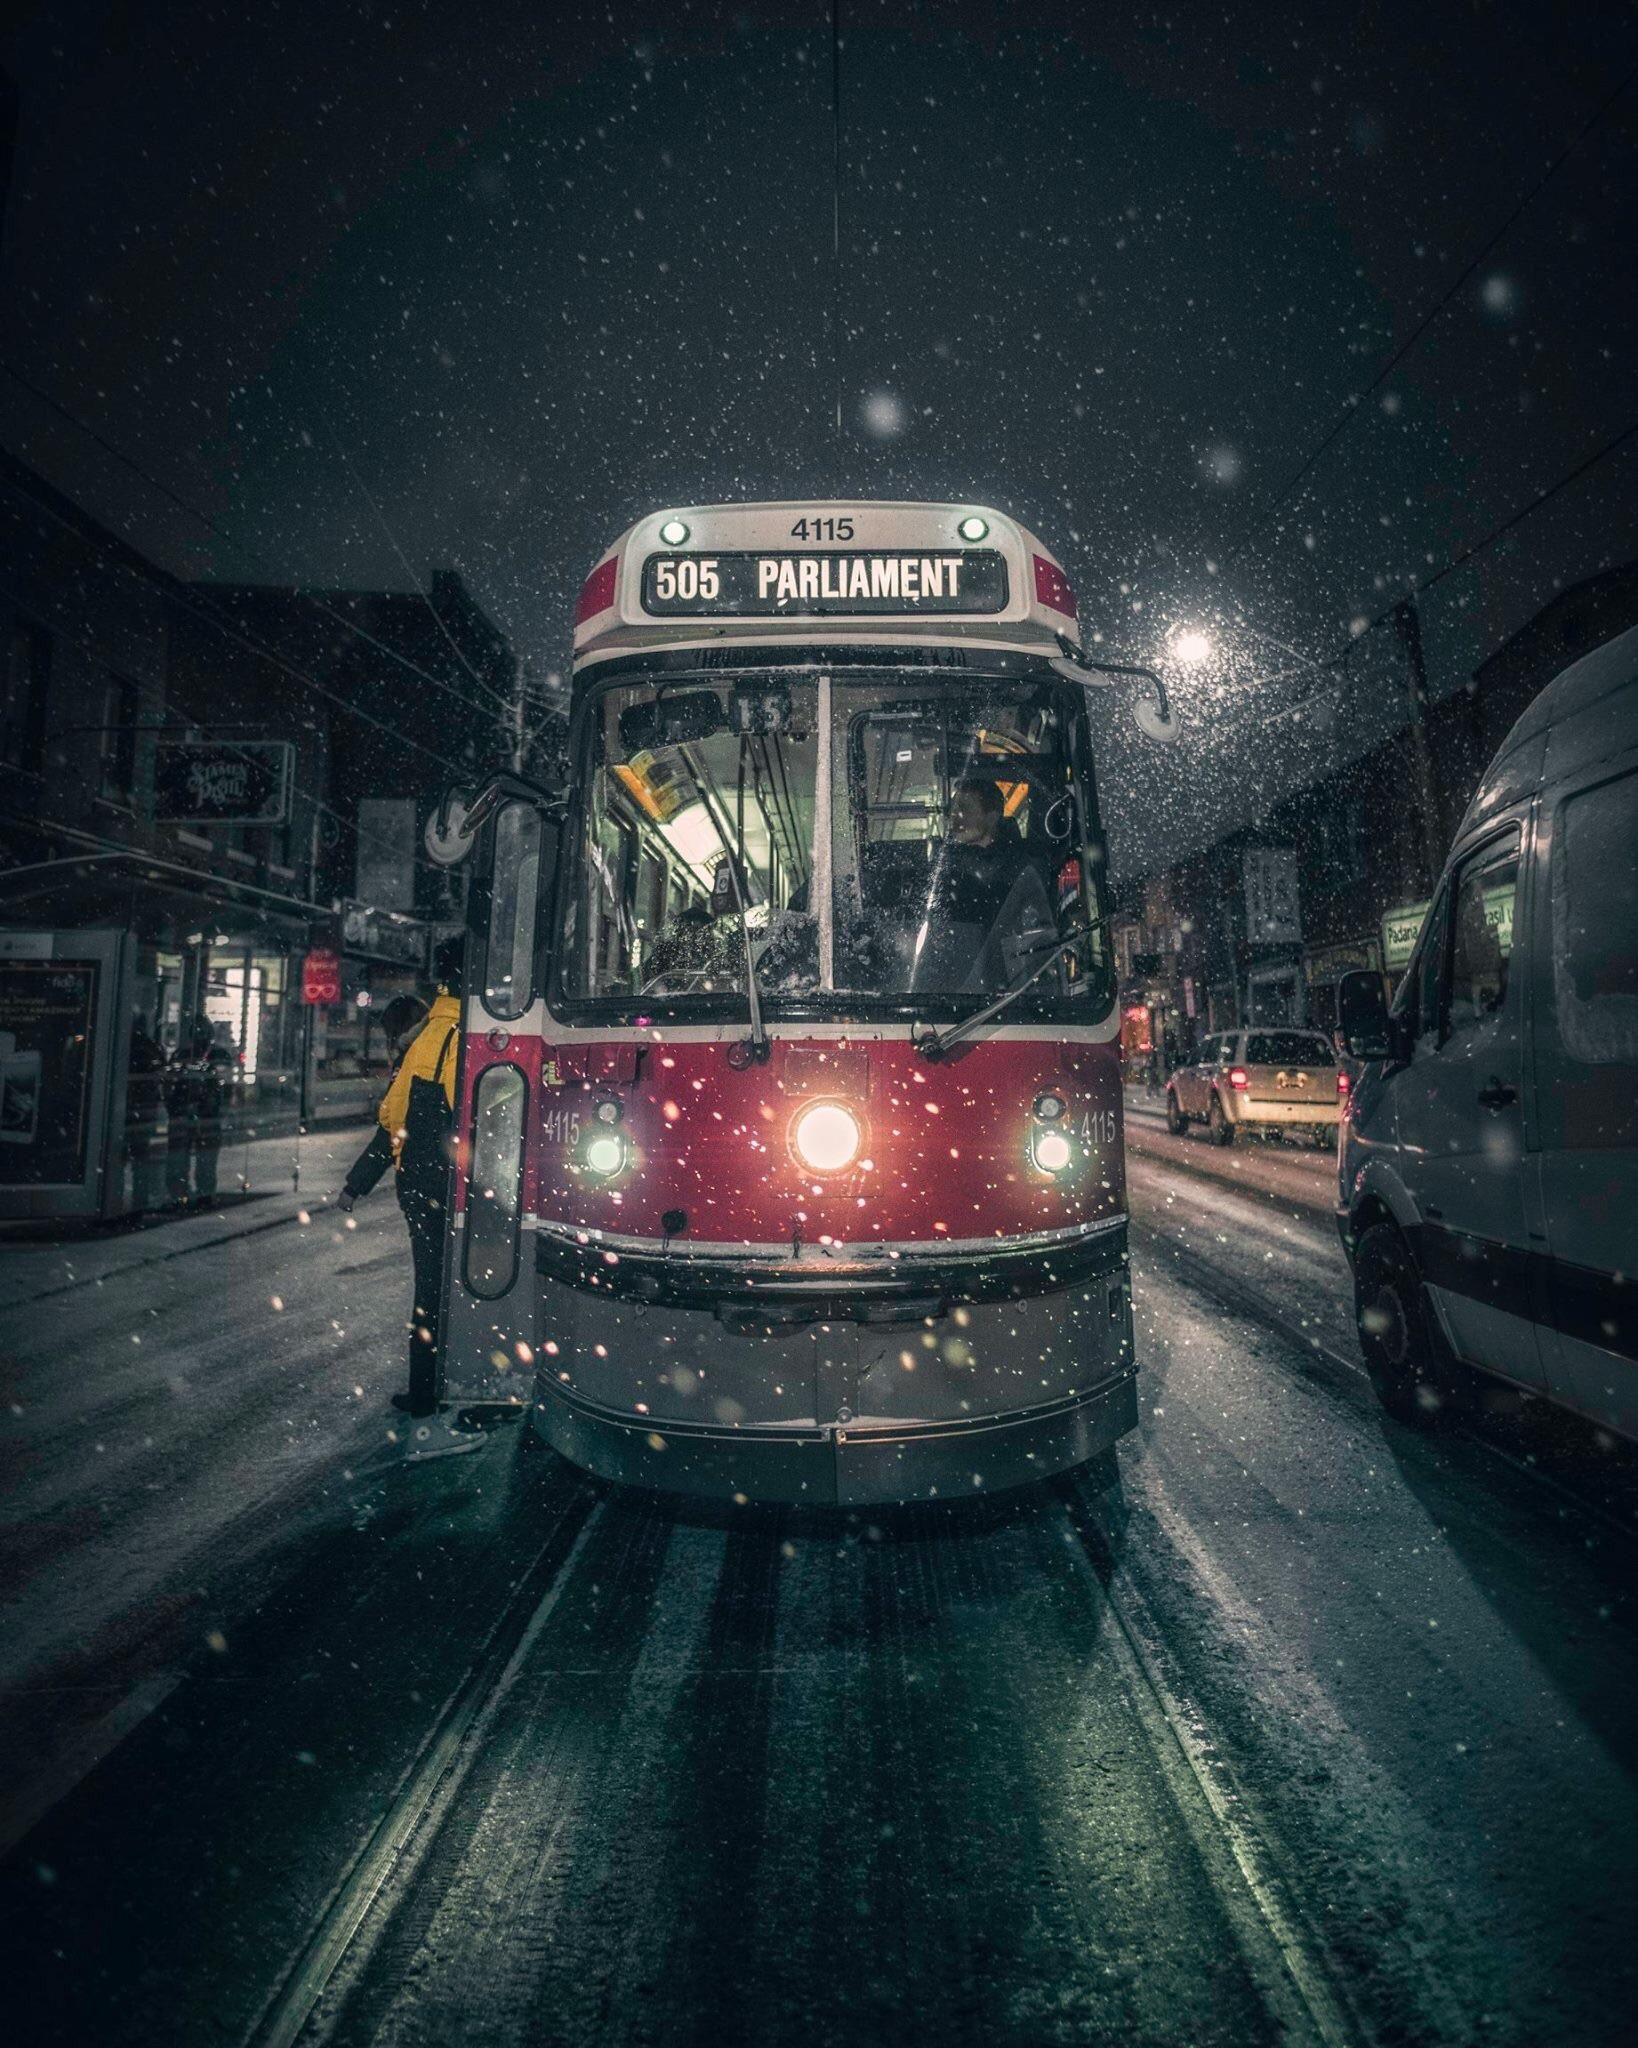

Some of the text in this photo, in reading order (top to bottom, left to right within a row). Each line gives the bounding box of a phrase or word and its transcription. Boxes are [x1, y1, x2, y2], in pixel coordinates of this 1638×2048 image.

[790, 518, 855, 541] 4115
[656, 559, 964, 600] 505 PARLIAMENT
[545, 1110, 579, 1145] 4115
[1081, 1110, 1117, 1144] 4115
